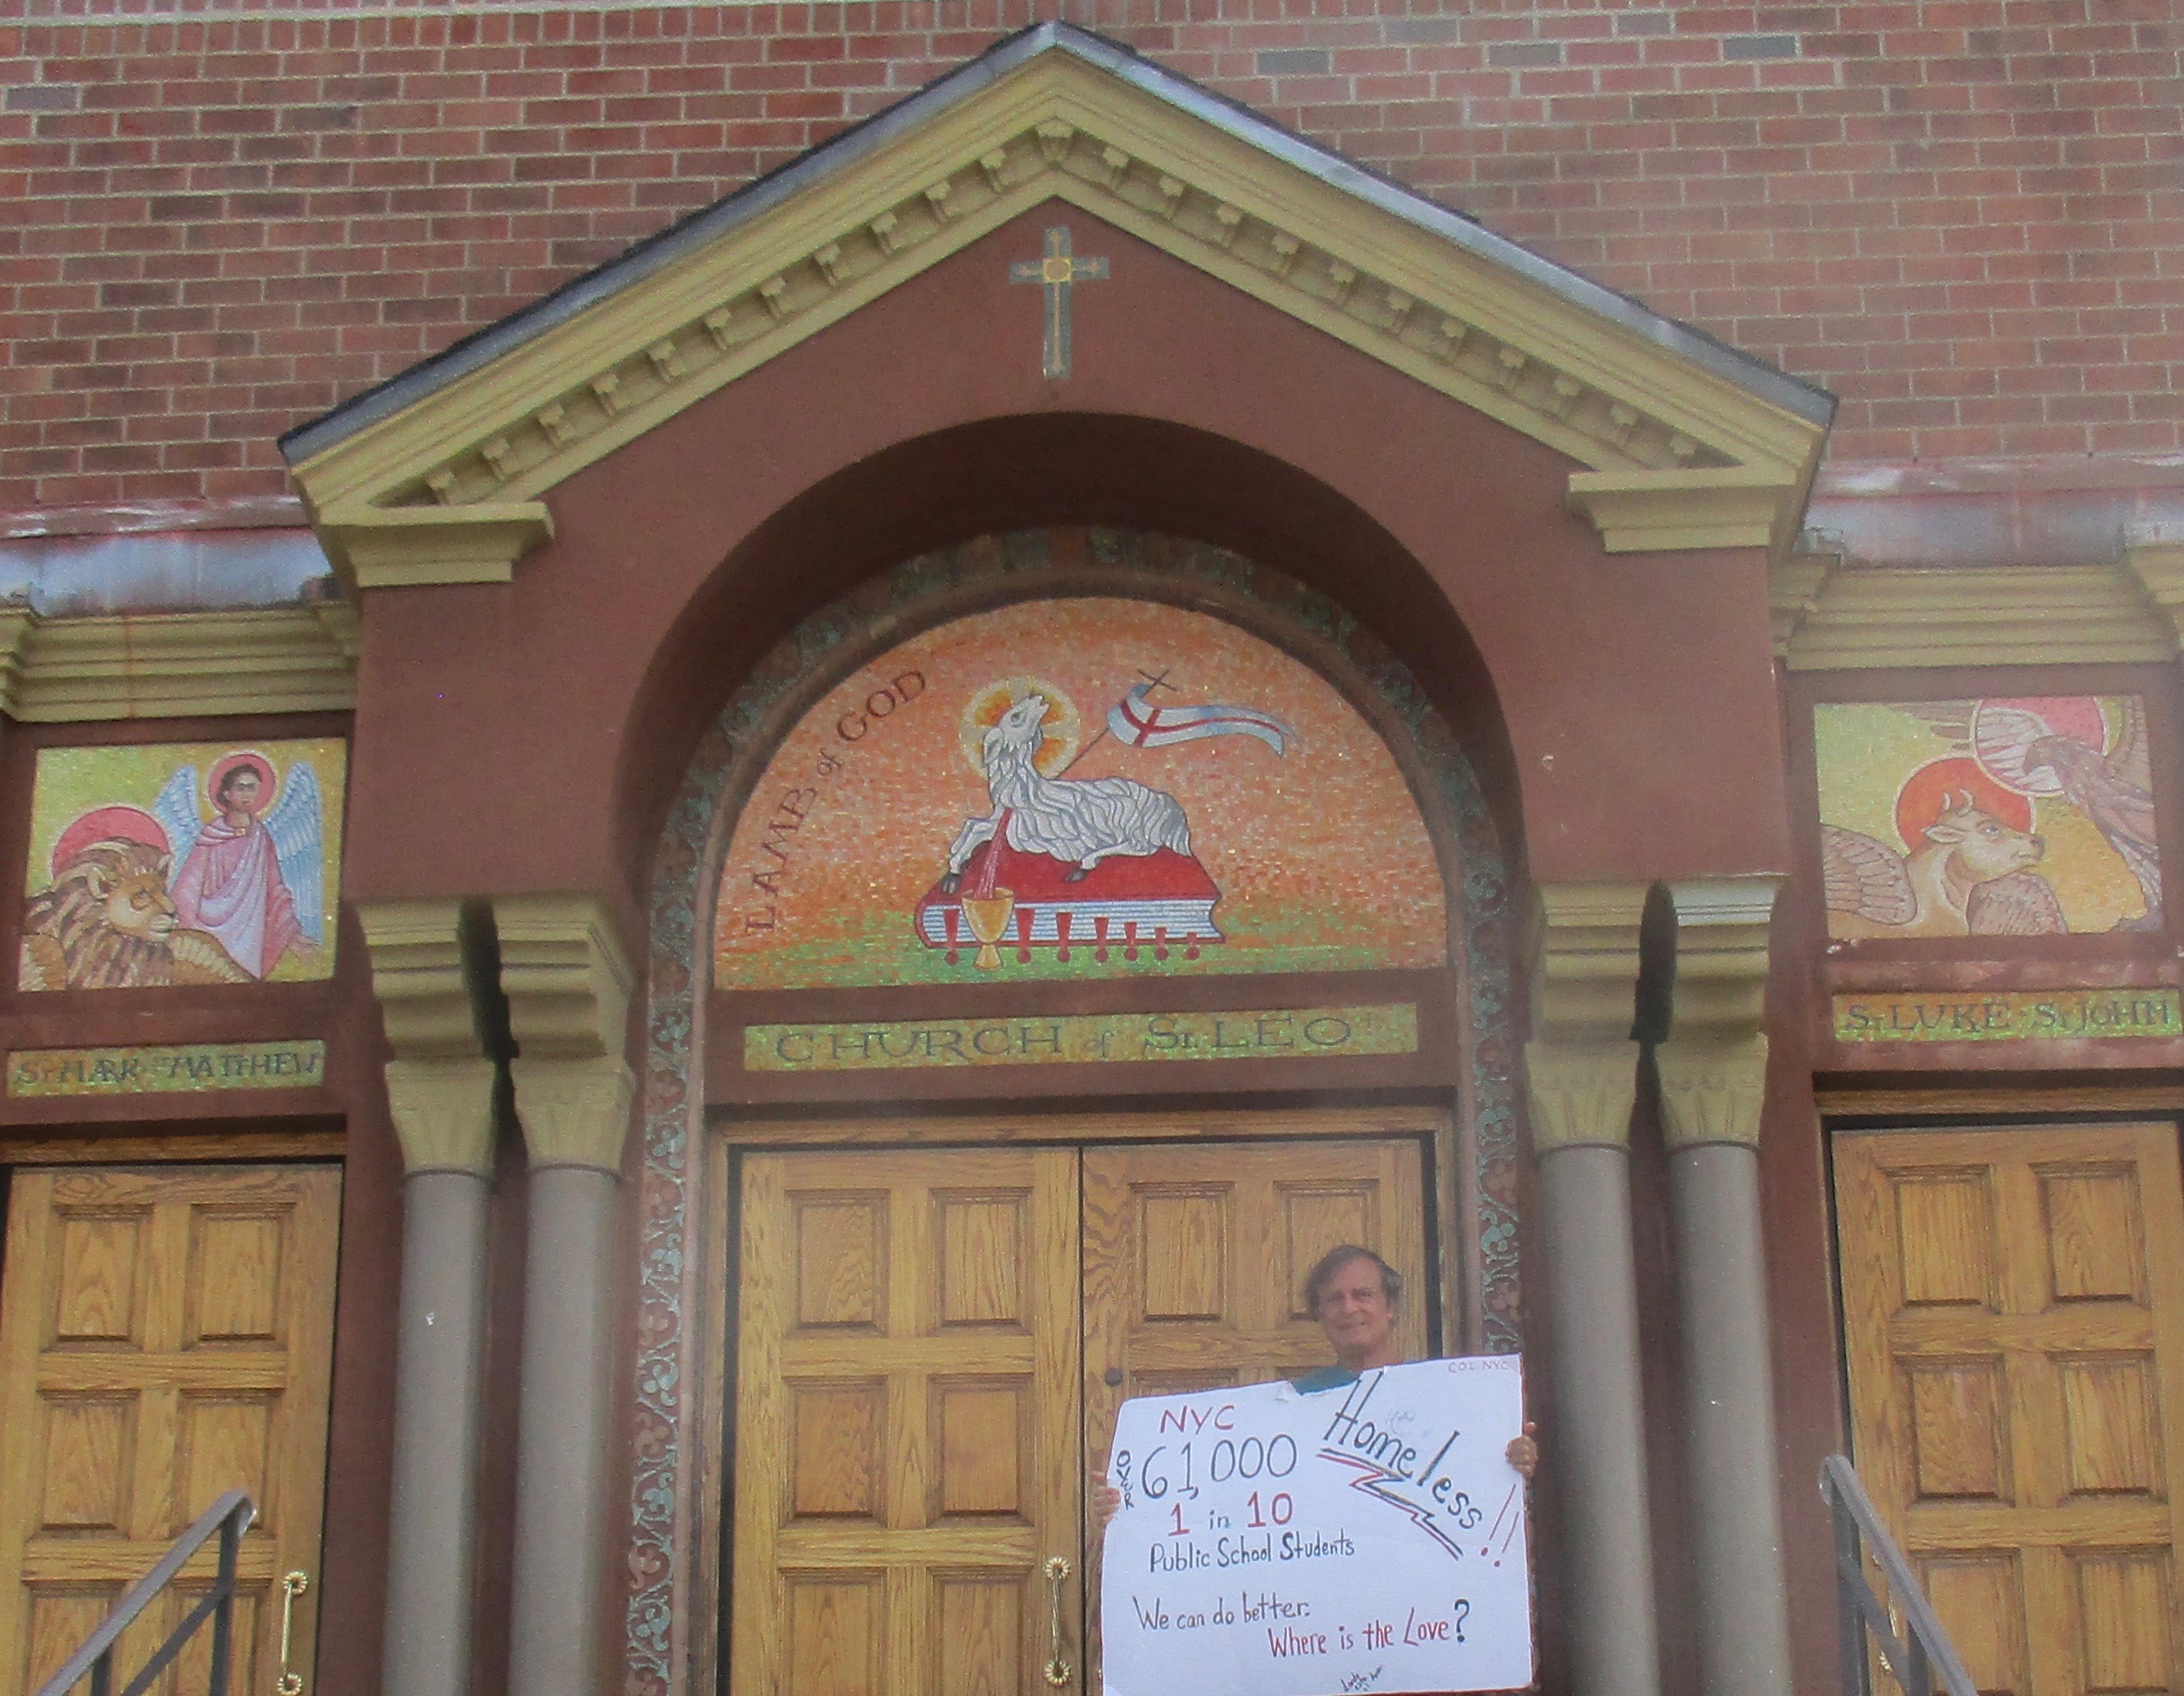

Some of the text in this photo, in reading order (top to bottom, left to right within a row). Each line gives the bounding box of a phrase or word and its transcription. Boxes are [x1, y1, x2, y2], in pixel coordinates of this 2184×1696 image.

[746, 787, 817, 933] LAMB
[837, 670, 926, 743] GOD
[776, 1025, 1062, 1062] CHURCH
[1086, 1029, 1115, 1059] of
[1211, 1013, 1352, 1050] LEO
[1160, 1405, 1235, 1433] NYC
[1141, 1433, 1298, 1500] 61,000
[1167, 1491, 1294, 1537] 1 in 10
[1149, 1527, 1356, 1574] Public School Students
[1132, 1594, 1170, 1632] We
[1176, 1611, 1205, 1629] can
[1213, 1596, 1235, 1625] do
[1267, 1598, 1471, 1658] Where is the Love?
